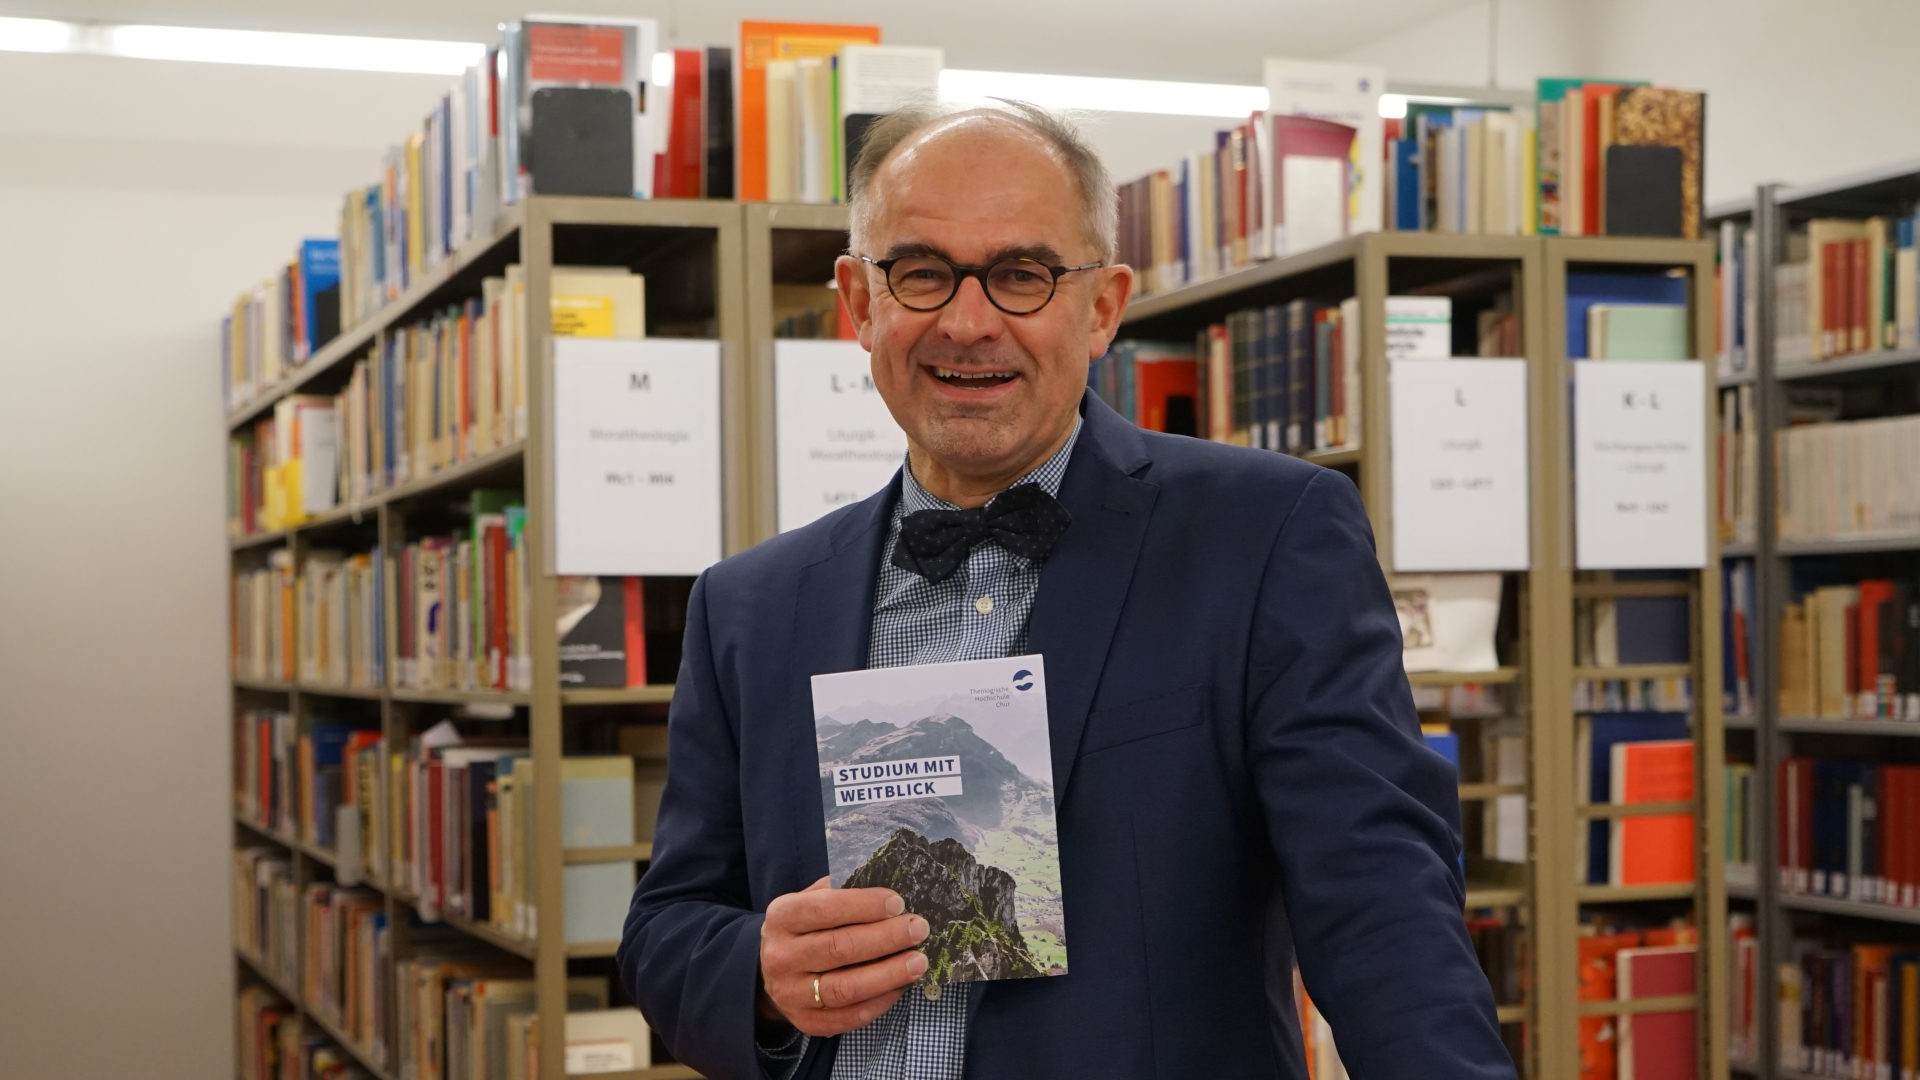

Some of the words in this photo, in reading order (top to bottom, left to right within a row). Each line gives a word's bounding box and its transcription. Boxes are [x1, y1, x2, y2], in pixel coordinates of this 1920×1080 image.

[630, 373, 650, 391] M
[831, 375, 843, 392] L
[1455, 388, 1468, 407] L
[1649, 392, 1660, 410] L
[970, 687, 1009, 695] Theologische
[974, 694, 1010, 702] Hochschule
[839, 762, 918, 782] STUDIUM
[924, 759, 955, 774] MIT
[841, 782, 936, 802] WEITBLICK
